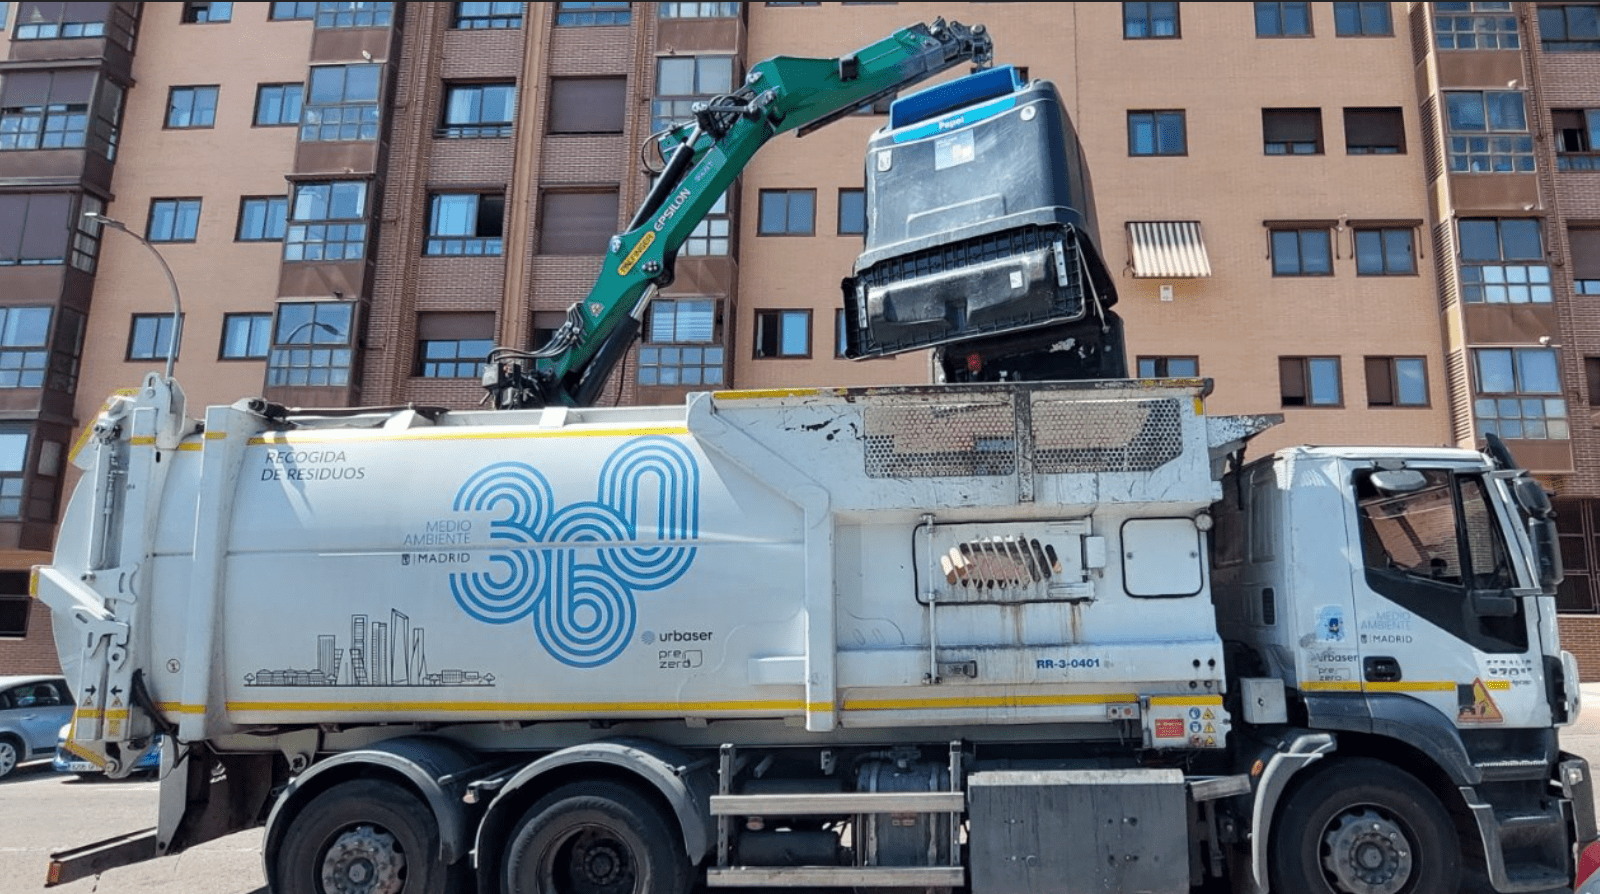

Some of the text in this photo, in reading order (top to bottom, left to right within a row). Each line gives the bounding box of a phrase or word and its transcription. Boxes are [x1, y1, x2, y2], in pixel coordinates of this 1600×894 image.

[265, 451, 346, 464] RECOGIDA
[261, 467, 365, 481] DE RESIDUOS
[426, 520, 472, 532] MEDIO
[403, 532, 471, 545] AMBIENTE
[418, 553, 471, 563] MADRID
[1361, 621, 1412, 630] AMBIENTE
[659, 630, 713, 642] urbaser
[1373, 635, 1413, 644] MADRID
[1036, 659, 1100, 669] RR-3-0401
